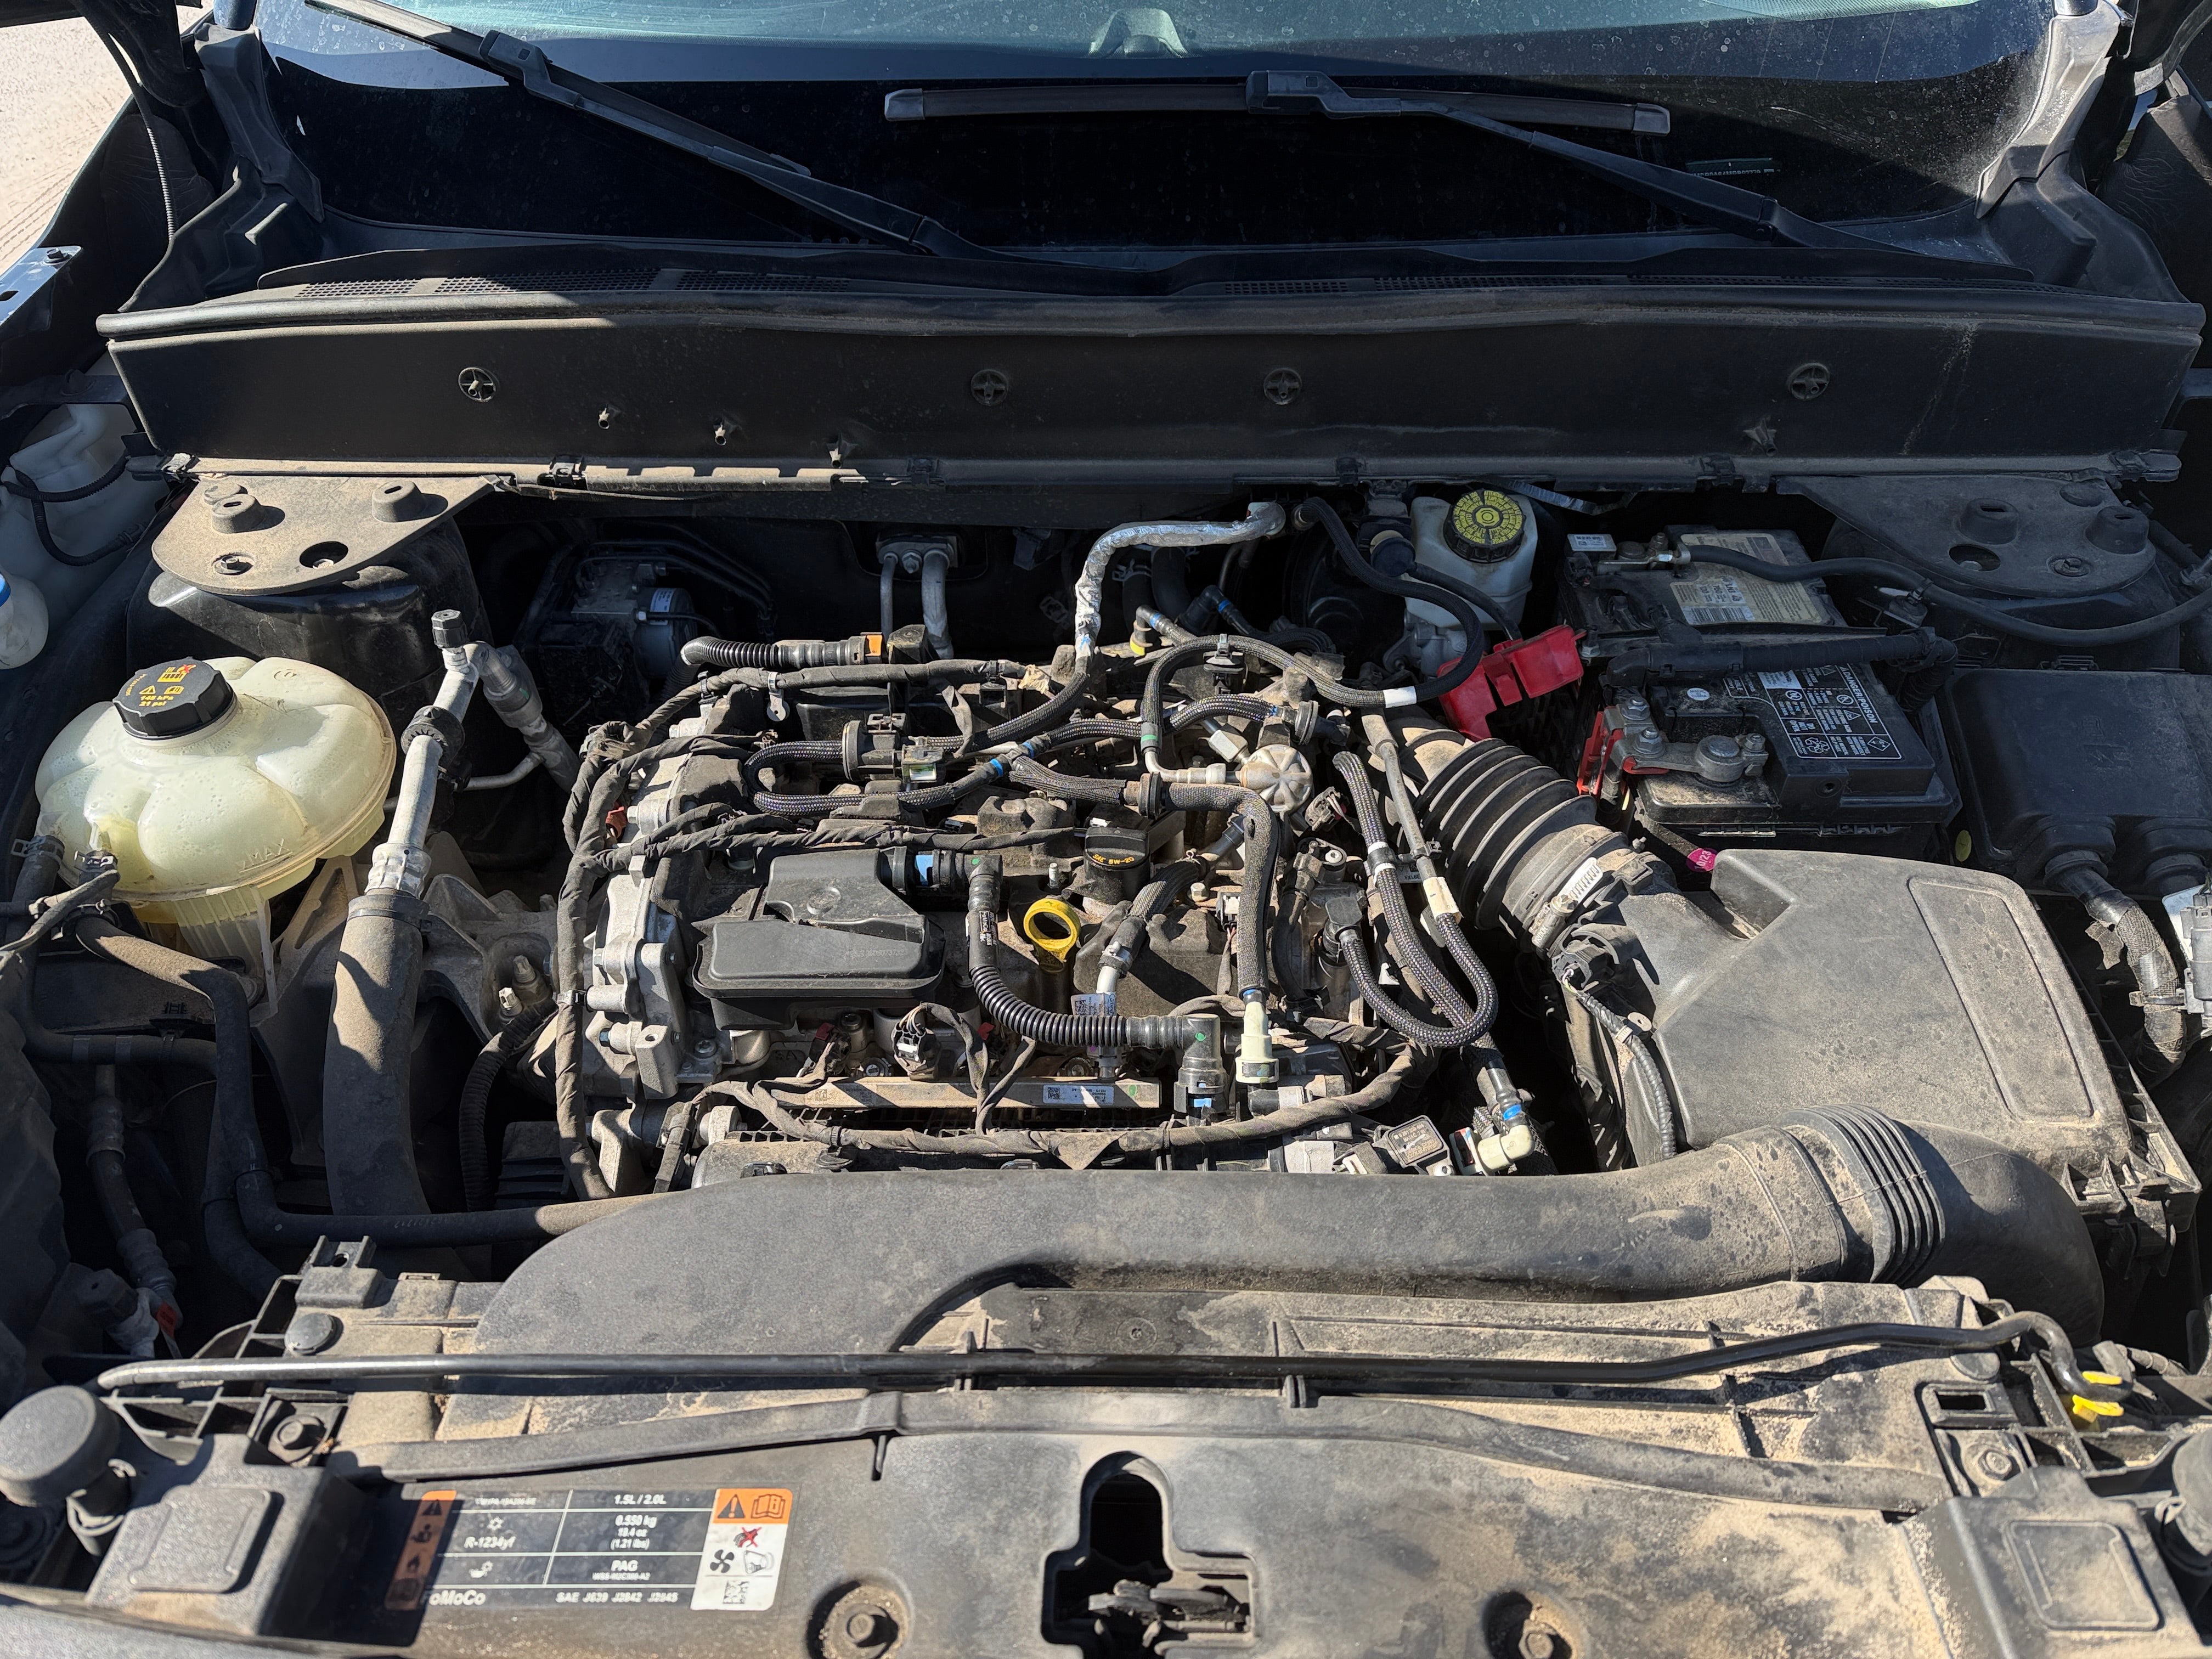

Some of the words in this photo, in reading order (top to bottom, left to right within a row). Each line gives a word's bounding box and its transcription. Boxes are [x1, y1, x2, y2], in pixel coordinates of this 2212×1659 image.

[1843, 672, 1878, 723] DANGER/POISON
[243, 838, 290, 870] MAX
[1092, 854, 1107, 863] SAE
[1108, 856, 1135, 865] 5W-20
[1694, 850, 1712, 870] 10/23
[980, 912, 989, 932] FoMoCo
[614, 1494, 636, 1505] 1.5L
[644, 1494, 667, 1505] 2.0L
[643, 1515, 657, 1528] kg
[464, 1536, 516, 1550] R-1234yf
[632, 1538, 650, 1550] lbs)
[611, 1560, 639, 1572] PAG
[421, 1590, 486, 1606] FoMoCo
[556, 1592, 580, 1603] SAE
